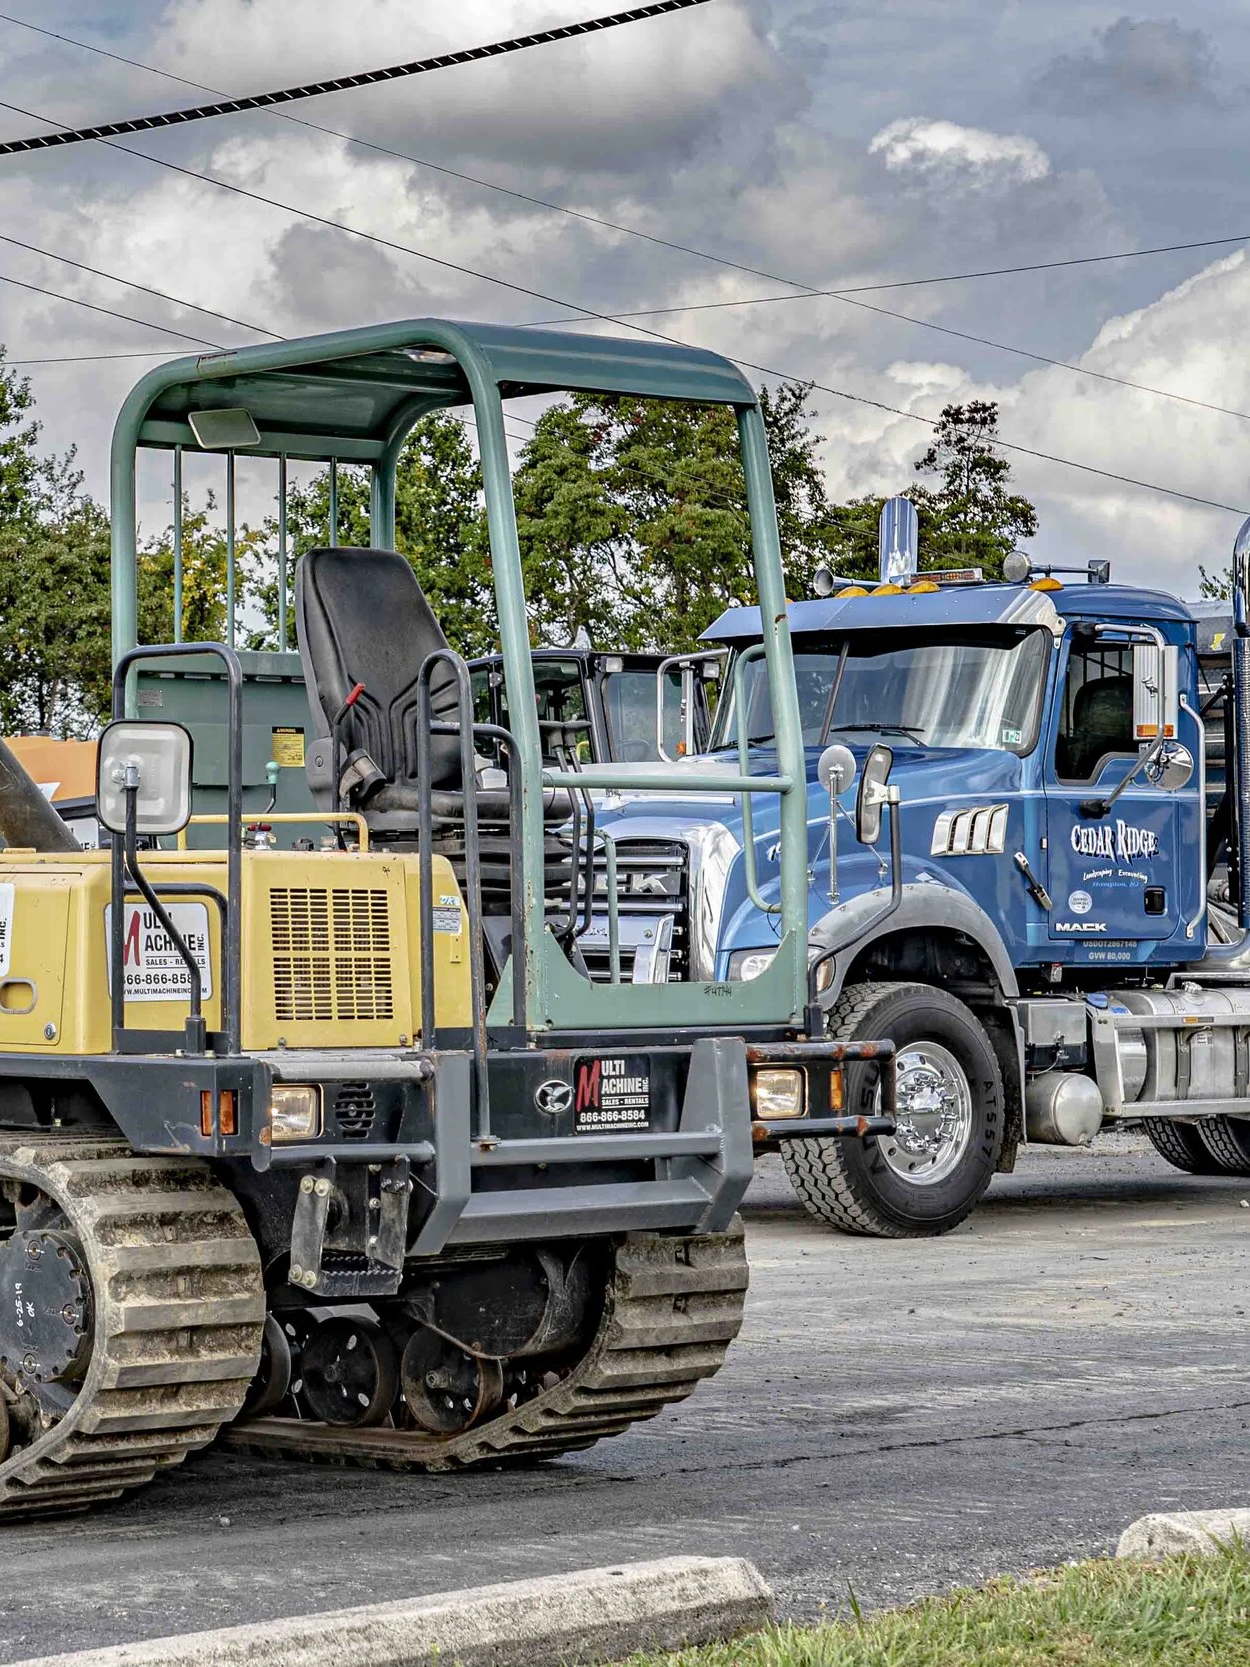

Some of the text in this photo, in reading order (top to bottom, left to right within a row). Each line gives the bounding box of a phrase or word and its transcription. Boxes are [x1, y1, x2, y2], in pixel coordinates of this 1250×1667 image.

[1071, 819, 1158, 863] CEDAR RIDGE
[1056, 922, 1107, 931] MACK
[1088, 951, 1106, 960] GVW
[580, 1110, 645, 1123] 866-866-8584
